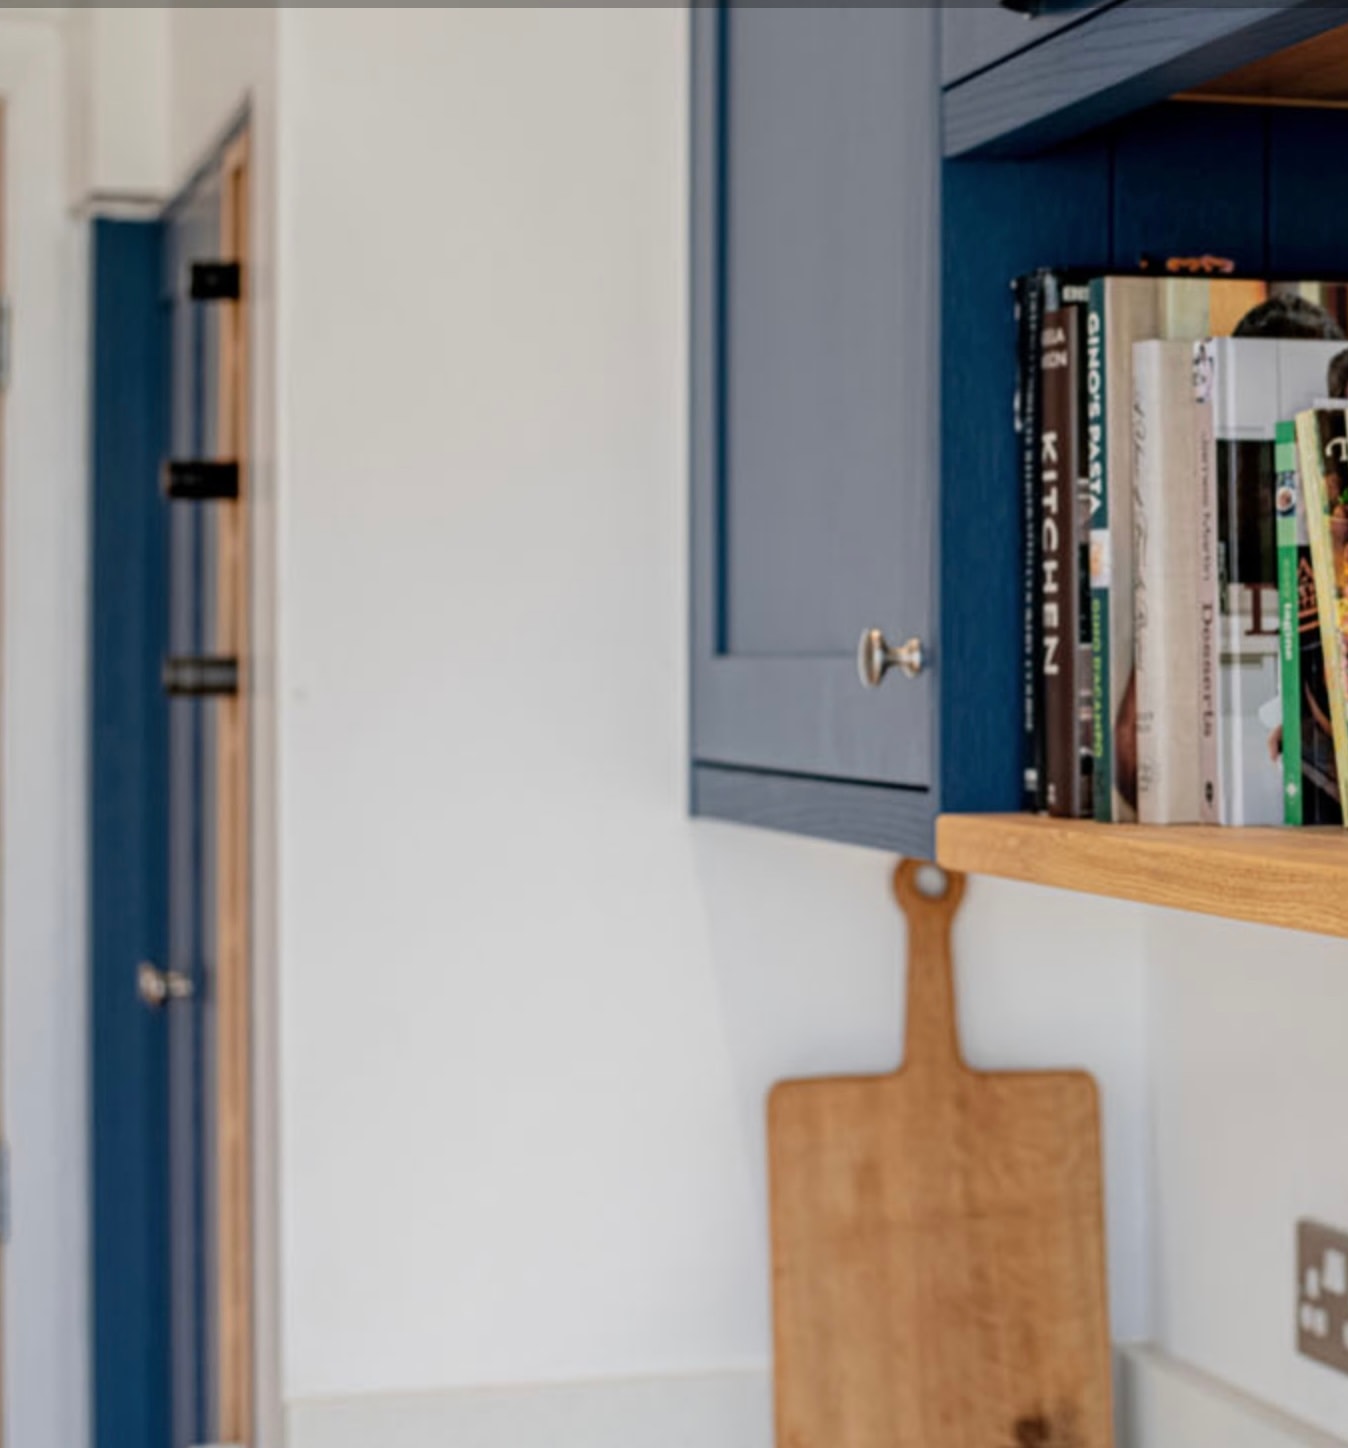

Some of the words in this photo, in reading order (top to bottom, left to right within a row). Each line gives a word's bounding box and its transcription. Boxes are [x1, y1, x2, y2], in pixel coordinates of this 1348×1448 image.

[1086, 311, 1102, 419] GINO'S
[1088, 423, 1104, 514] PASTA
[1041, 432, 1060, 677] KITCHEN
[1201, 603, 1214, 738] Desserts
